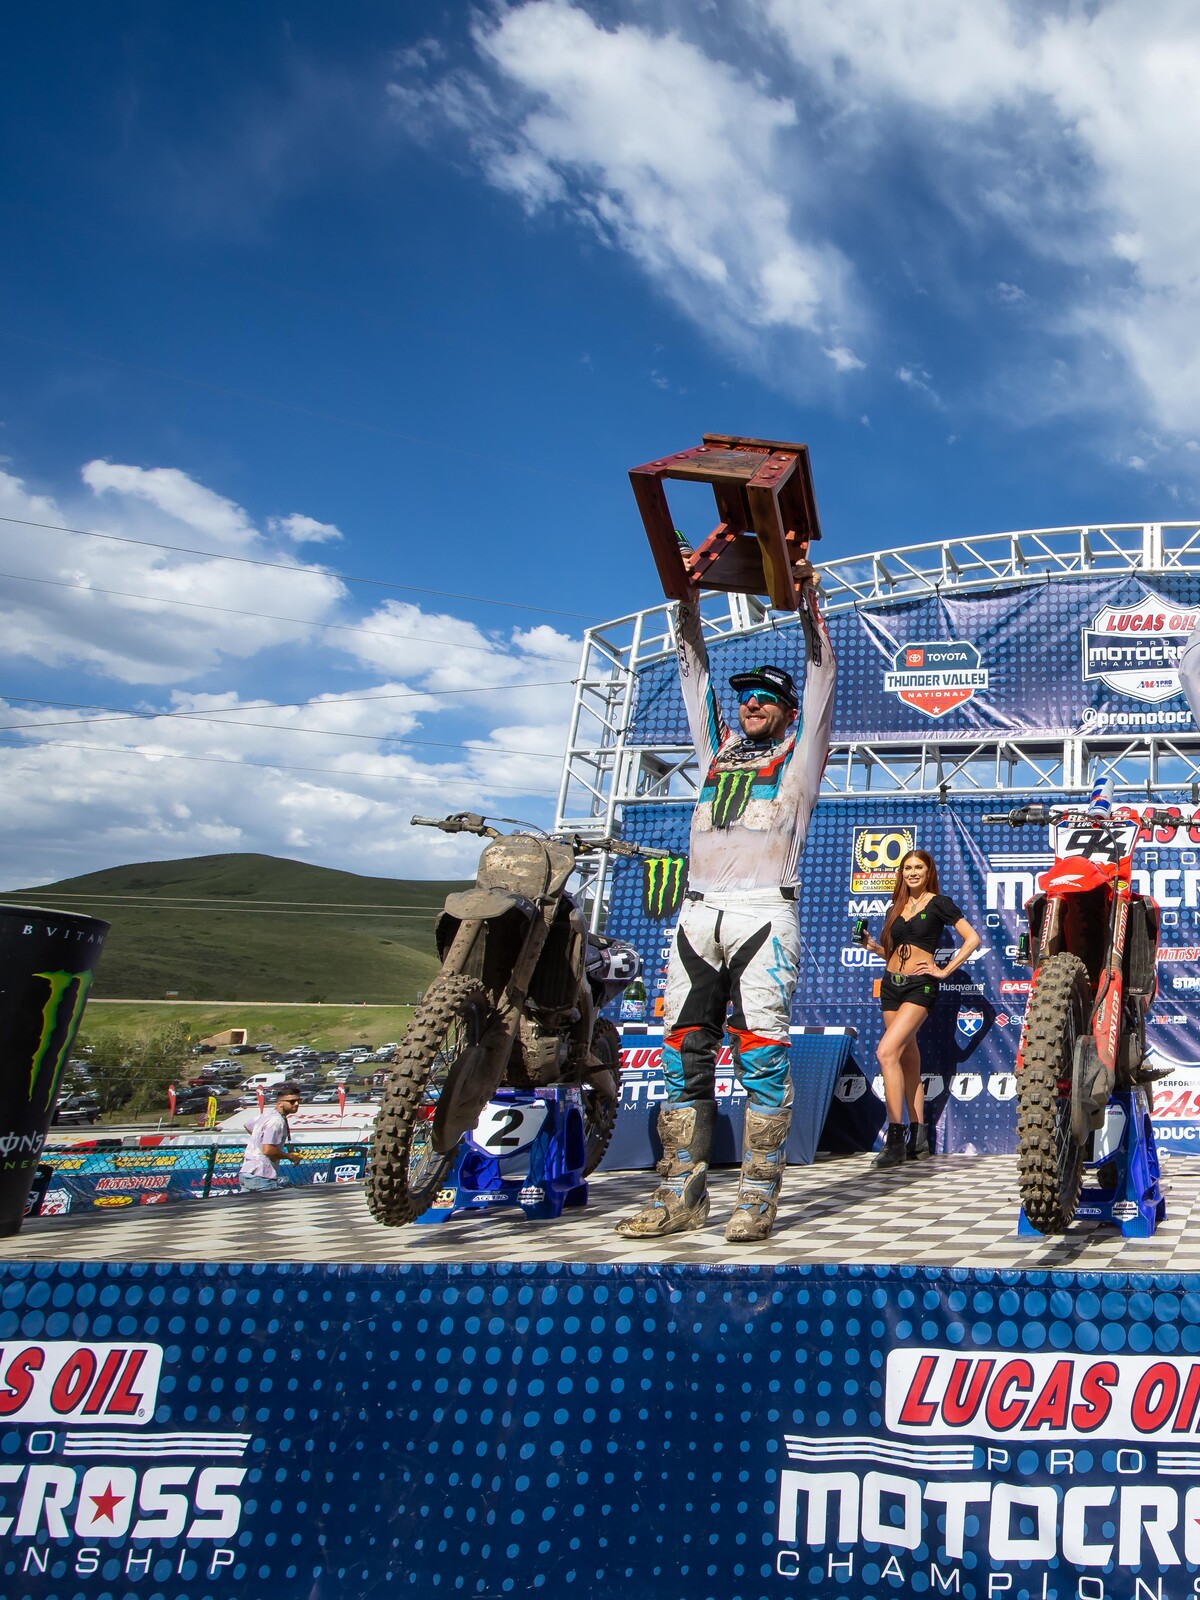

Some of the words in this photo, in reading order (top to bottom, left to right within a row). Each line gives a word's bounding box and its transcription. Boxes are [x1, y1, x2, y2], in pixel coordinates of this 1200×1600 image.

[1106, 613, 1166, 631] LUCAS
[1169, 614, 1197, 631] OIL
[927, 652, 968, 662] TOYOTA
[887, 674, 940, 687] THUNDER
[942, 672, 986, 686] VALLEY
[862, 834, 908, 868] 50
[1066, 829, 1127, 862] 94
[1145, 852, 1196, 864] RO
[23, 924, 33, 934] B
[939, 983, 984, 992] Husqvarna
[964, 1020, 978, 1031] X
[1107, 989, 1120, 1060] DUNLOP
[485, 1109, 524, 1146] 2
[899, 1355, 1118, 1434] LUCAS
[988, 1449, 1144, 1475] PRO
